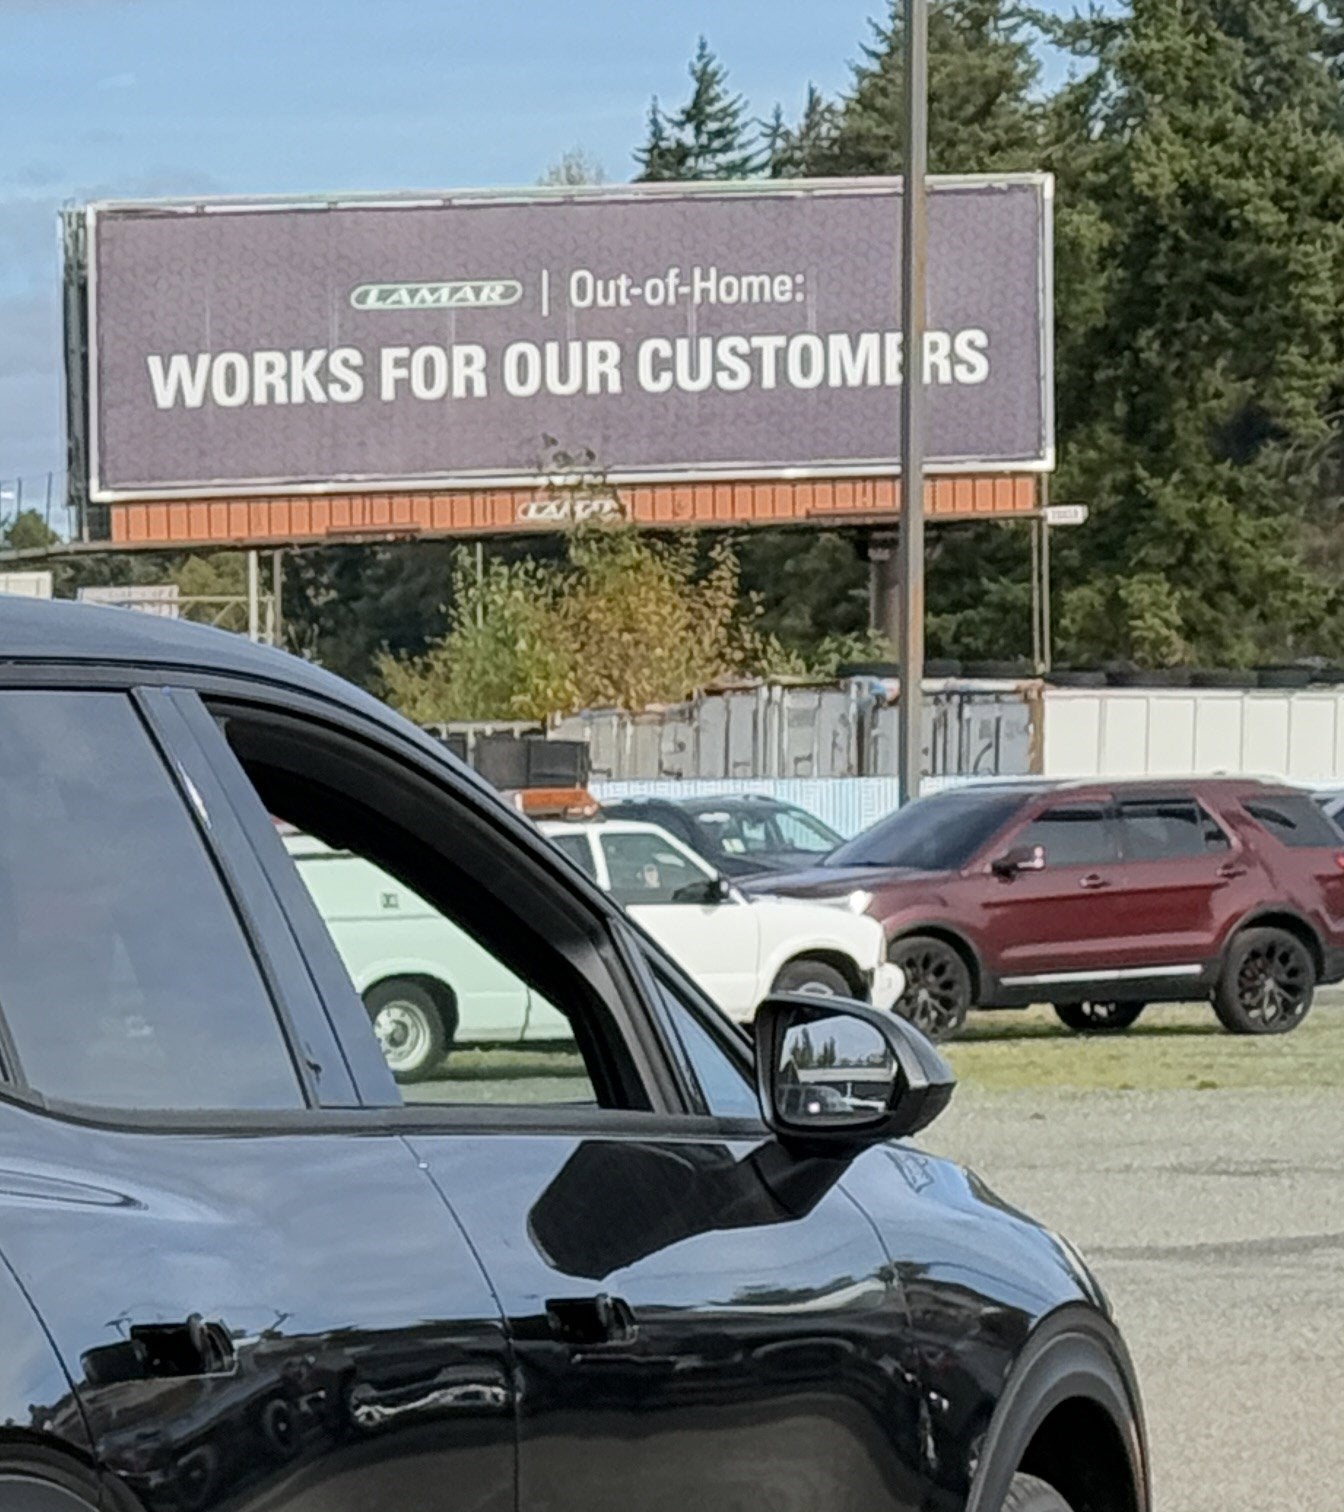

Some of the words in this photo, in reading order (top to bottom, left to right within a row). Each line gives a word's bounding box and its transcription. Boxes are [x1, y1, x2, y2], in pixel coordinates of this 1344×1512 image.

[365, 284, 506, 306] LAMAR
[570, 267, 805, 308] Out-of-Home:
[147, 347, 364, 409] WORKS
[380, 344, 487, 400] FOR
[504, 340, 622, 396] OUR
[638, 328, 989, 393] CUSTOMERS
